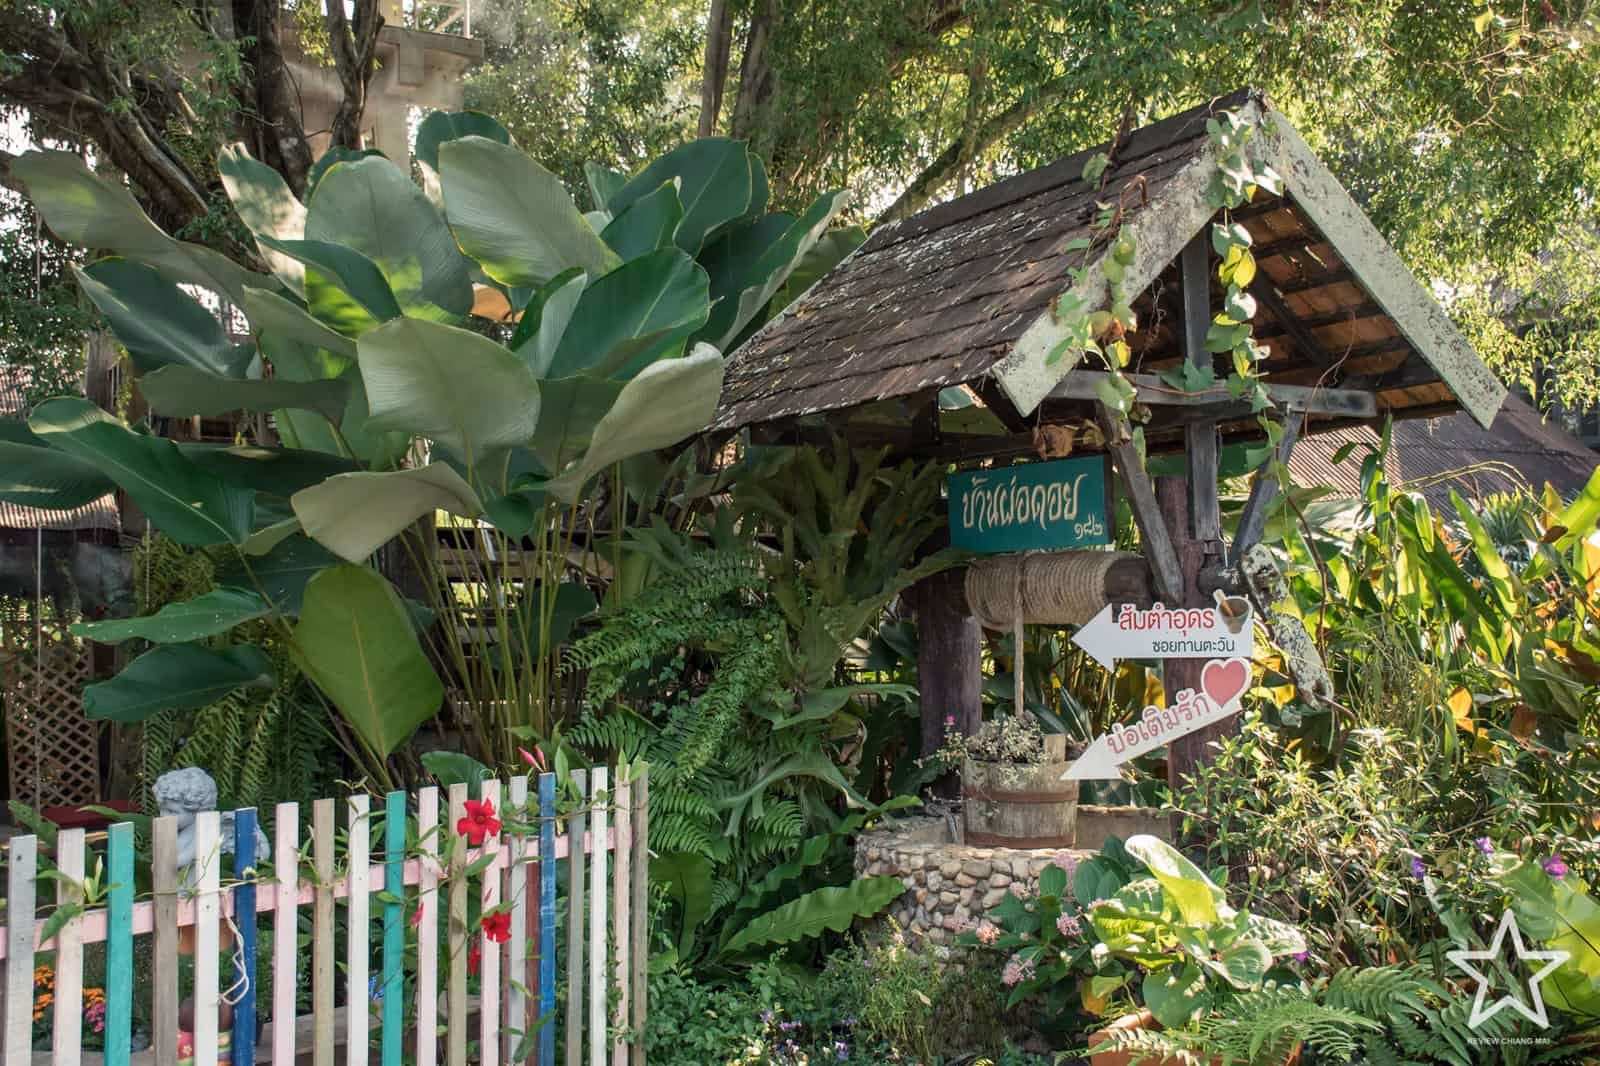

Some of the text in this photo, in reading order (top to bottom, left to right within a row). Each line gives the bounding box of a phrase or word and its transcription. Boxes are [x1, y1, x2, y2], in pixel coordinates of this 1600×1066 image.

[1119, 603, 1215, 637] ส้มตำอุดร
[1152, 637, 1235, 653] ซอยทานตะวัน
[1106, 691, 1210, 754] บ่อเติมรัก
